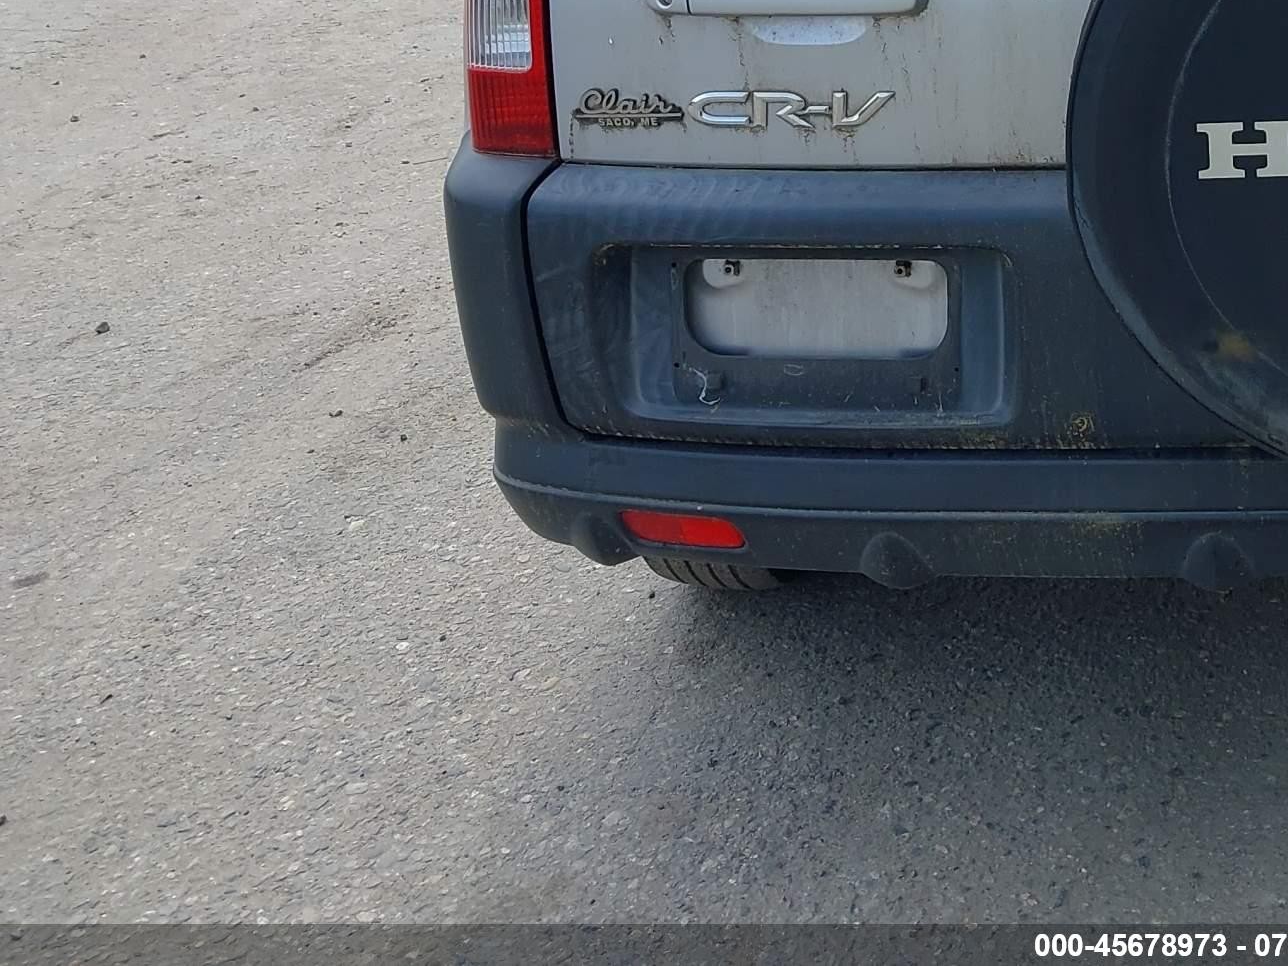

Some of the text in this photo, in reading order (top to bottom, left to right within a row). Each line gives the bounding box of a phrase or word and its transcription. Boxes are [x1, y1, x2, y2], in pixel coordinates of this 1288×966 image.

[581, 89, 673, 114] Clair
[688, 90, 896, 130] CR-V
[598, 117, 659, 127] SACO, ME
